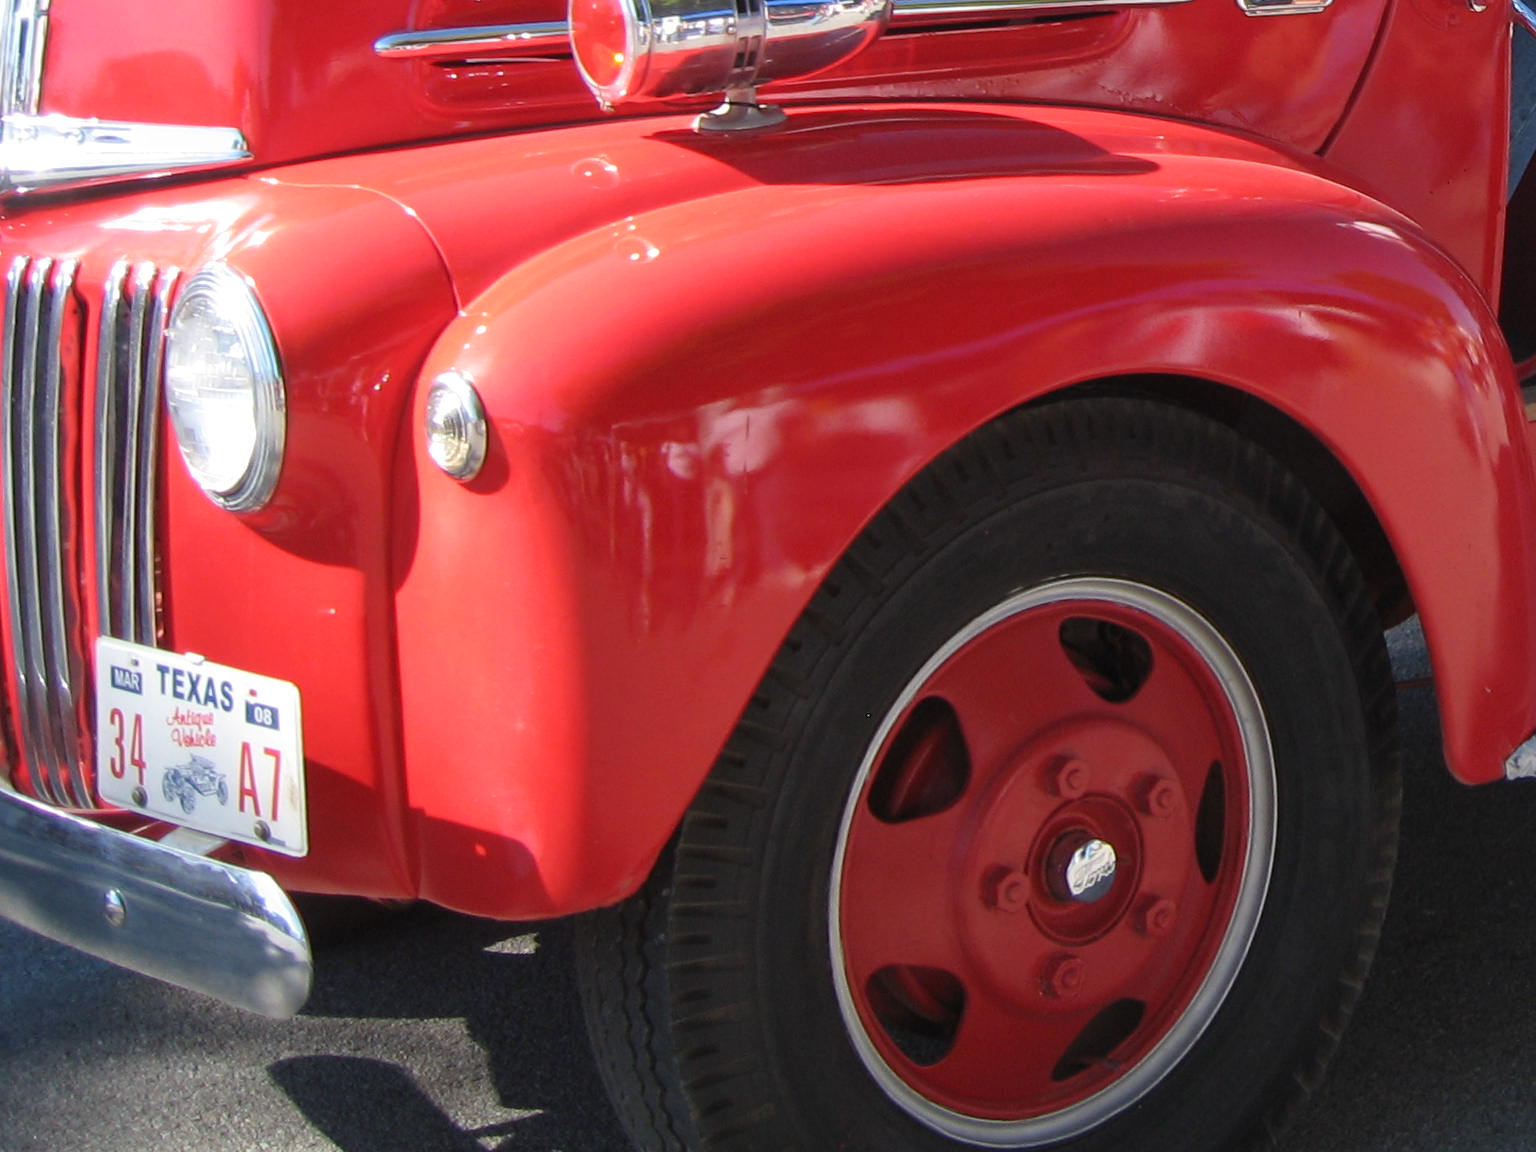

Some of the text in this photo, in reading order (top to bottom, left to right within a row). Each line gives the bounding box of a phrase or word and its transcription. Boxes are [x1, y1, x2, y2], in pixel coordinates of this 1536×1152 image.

[114, 667, 140, 691] MAR
[156, 663, 234, 713] TEXAS
[166, 706, 215, 732] Antique
[253, 704, 273, 726] 08
[171, 727, 217, 748] Vehicle
[109, 707, 281, 822] 34 A7
